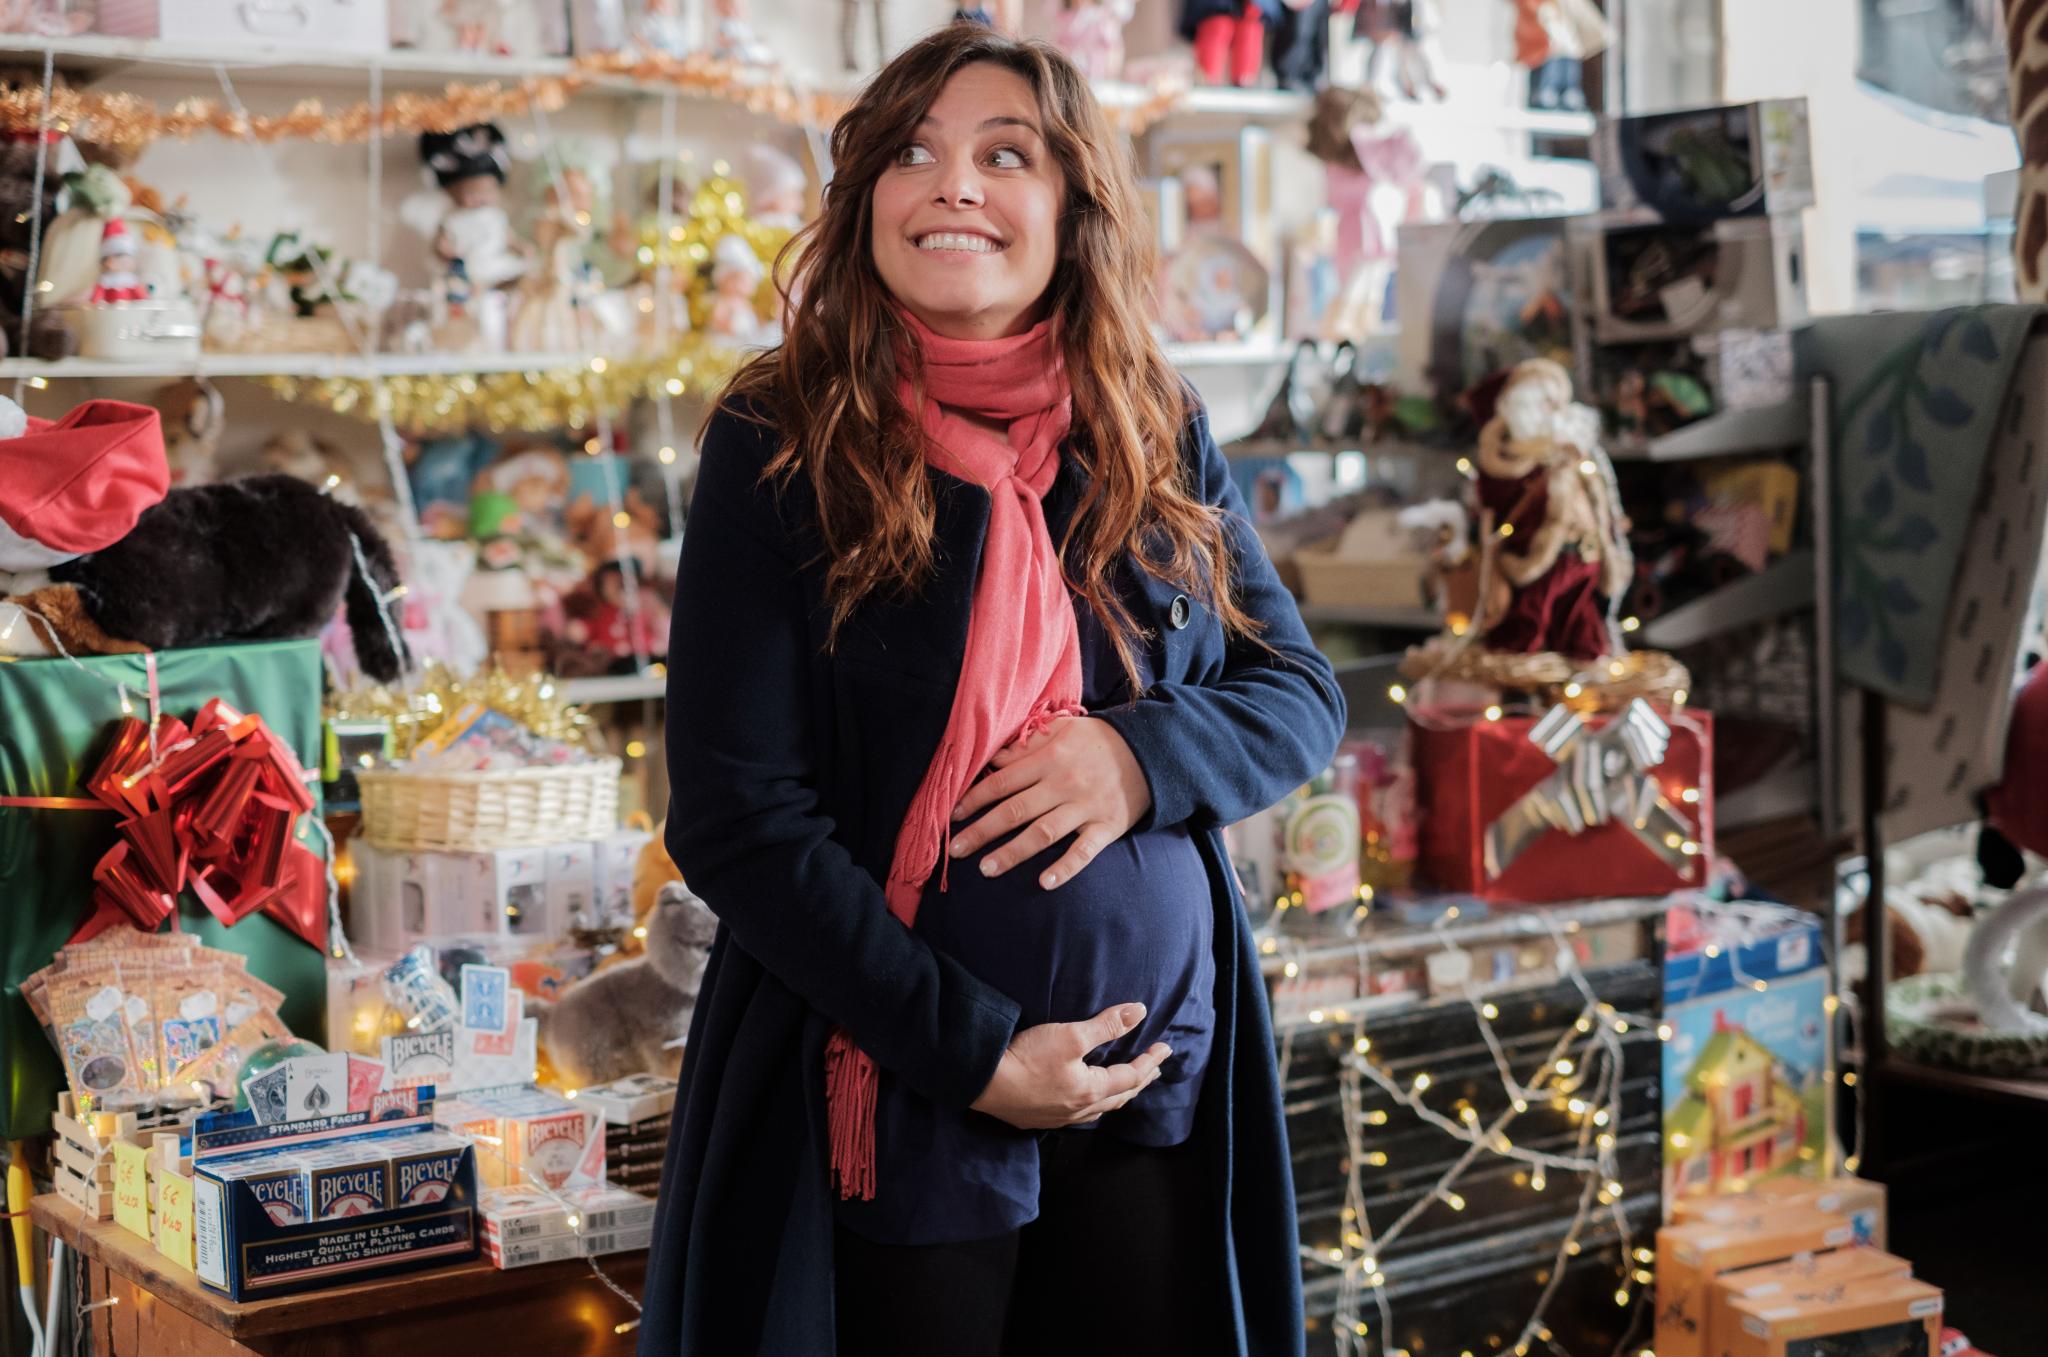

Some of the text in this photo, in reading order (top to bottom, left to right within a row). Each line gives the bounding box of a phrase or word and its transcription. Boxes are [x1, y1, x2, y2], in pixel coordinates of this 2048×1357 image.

[391, 1032, 453, 1074] BICYCLE
[373, 1090, 416, 1118] BICYCLE
[269, 1119, 327, 1135] STANDARD
[330, 1112, 366, 1124] FACES
[529, 1116, 584, 1157] BICYCLE
[250, 1178, 302, 1211] CYCLE
[320, 1170, 383, 1214] BICYCLE
[265, 1225, 456, 1264] HIGHEST QUALITY PLAYING CARDS
[319, 1225, 405, 1246] MADE IN U.S.A.
[312, 1242, 412, 1266] EASY TO SHUFFLE
